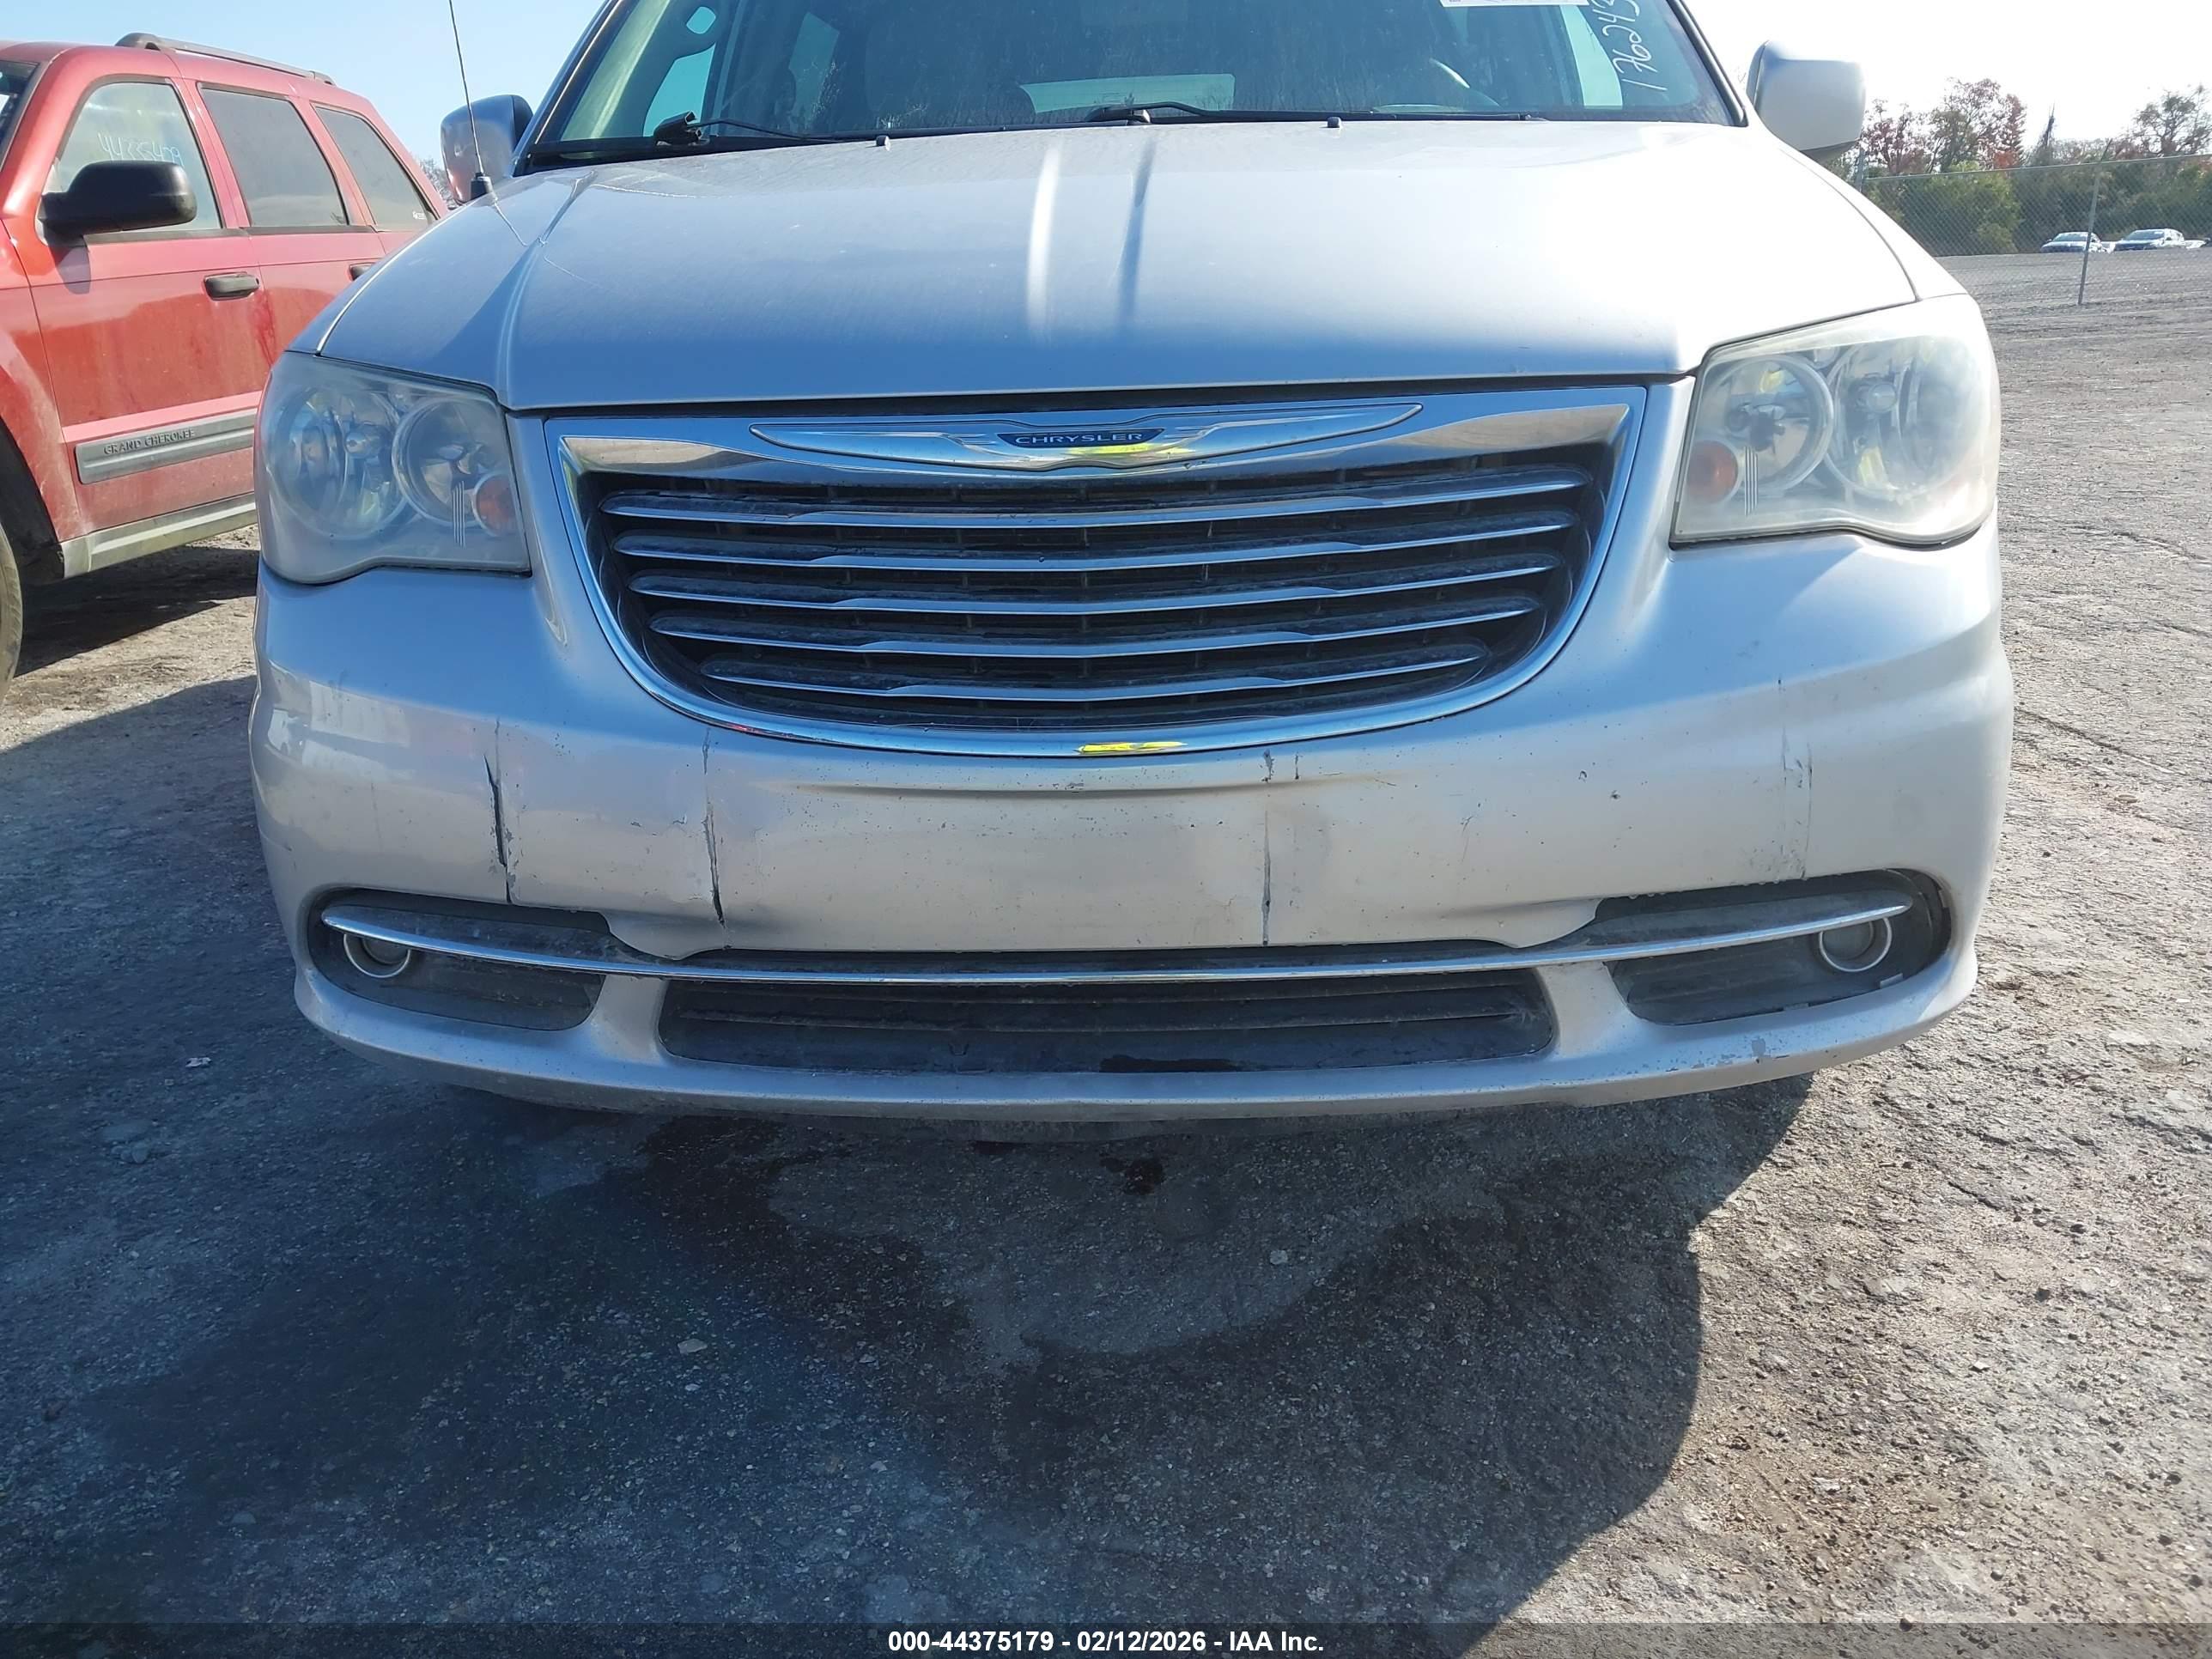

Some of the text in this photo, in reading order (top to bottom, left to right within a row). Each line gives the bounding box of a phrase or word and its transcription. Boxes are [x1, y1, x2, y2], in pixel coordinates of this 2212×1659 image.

[103, 428, 196, 455] GRAND CHEROKEE
[1015, 433, 1143, 445] CHRYSLER
